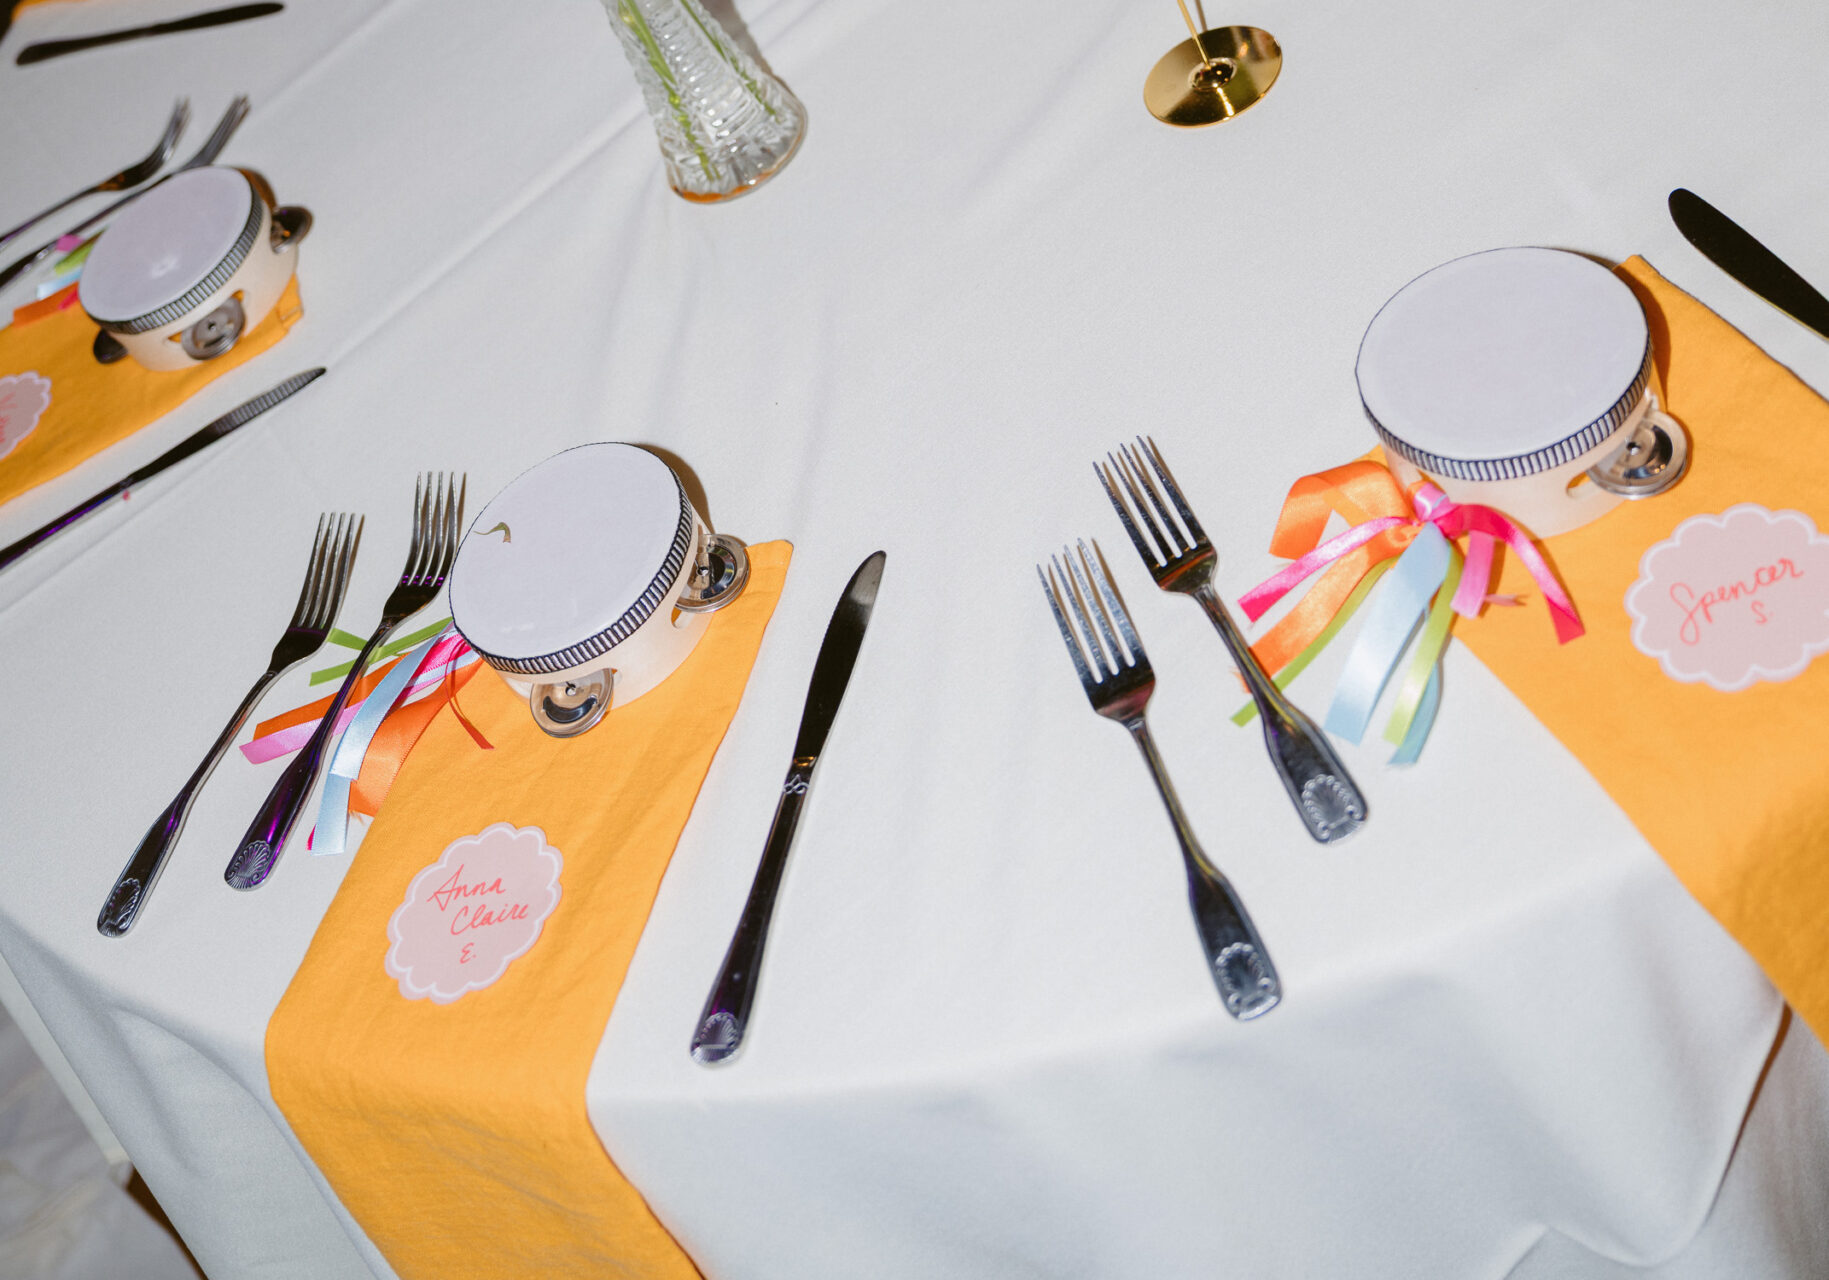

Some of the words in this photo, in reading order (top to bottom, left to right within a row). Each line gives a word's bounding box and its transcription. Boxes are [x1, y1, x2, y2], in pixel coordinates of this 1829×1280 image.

[1668, 557, 1804, 646] Spencer
[426, 863, 507, 912] Anna
[449, 902, 530, 936] Claire
[459, 942, 478, 965] E.
